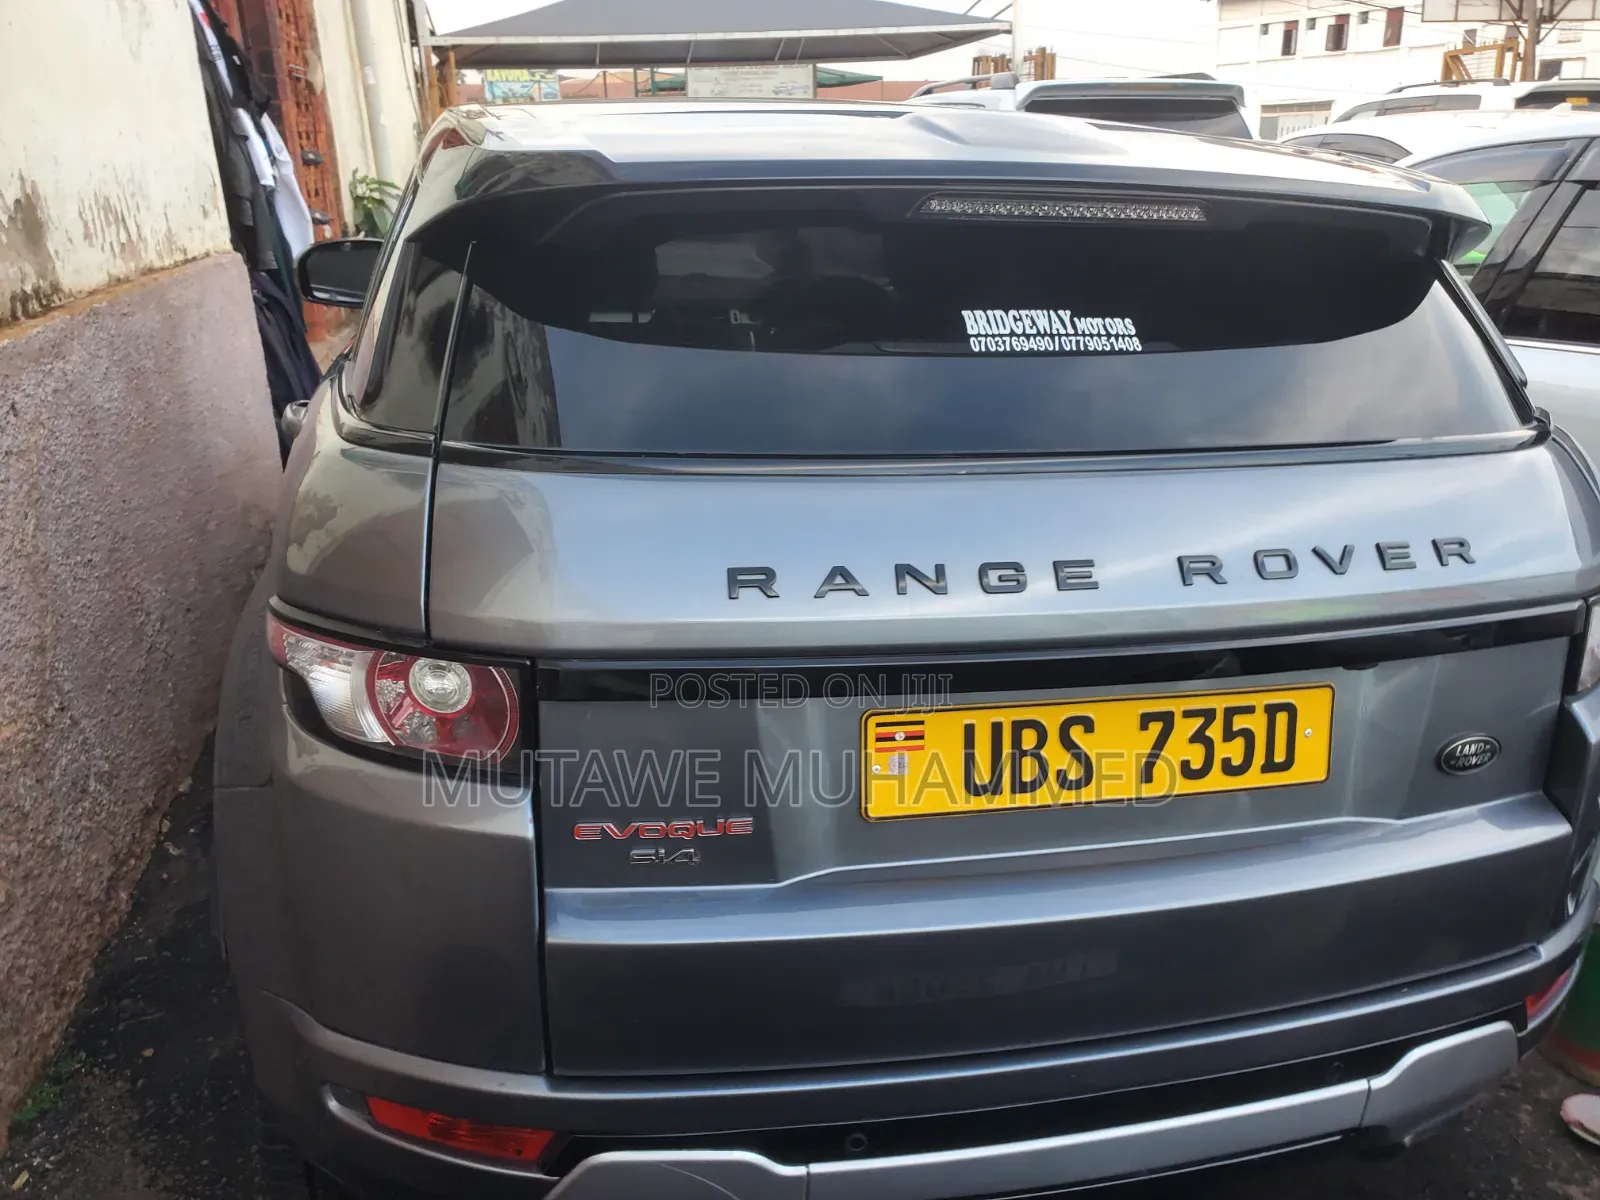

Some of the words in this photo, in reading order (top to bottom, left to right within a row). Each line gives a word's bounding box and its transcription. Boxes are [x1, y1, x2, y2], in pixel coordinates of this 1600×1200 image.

[961, 309, 1075, 335] BRIDGEWAY
[1073, 317, 1136, 336] MOTORS
[969, 336, 1142, 352] 0703769490/0779051408
[726, 559, 1100, 600] RANGE
[1176, 536, 1477, 586] ROVER
[962, 714, 1096, 798] UBS
[1138, 700, 1299, 785] 735D
[1455, 742, 1485, 757] LAND
[1455, 752, 1492, 768] ROVER
[573, 817, 754, 840] EVOQUE
[629, 848, 703, 866] Si4
